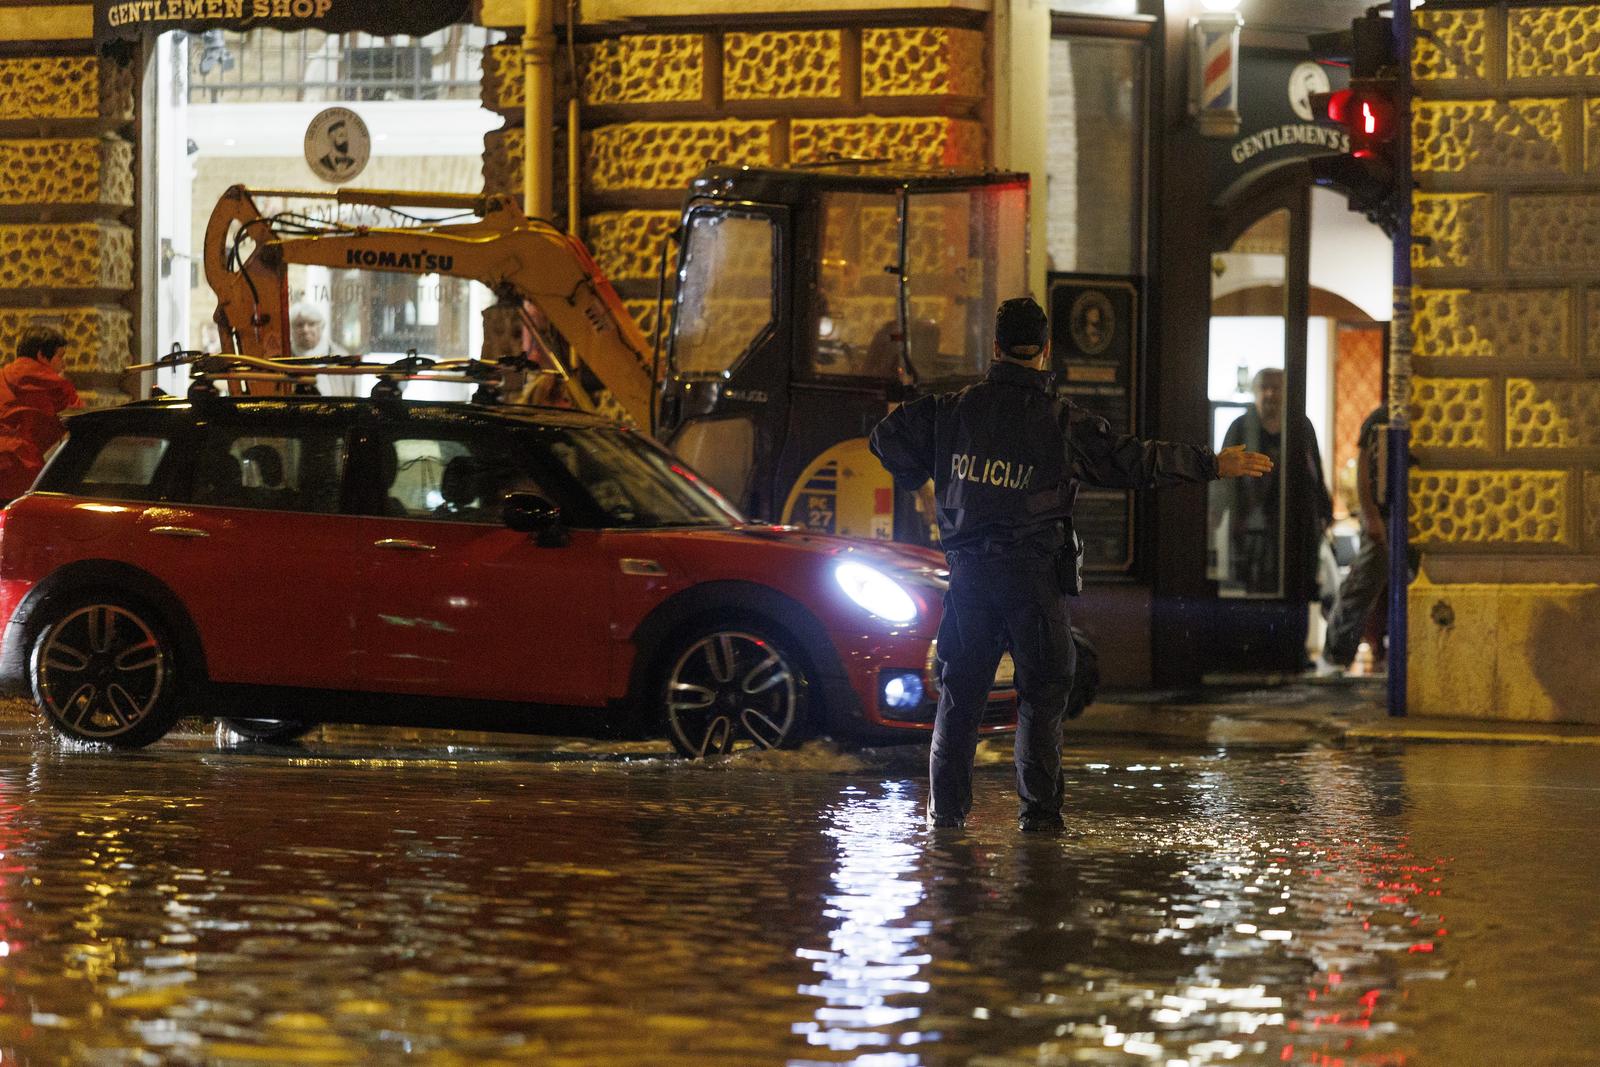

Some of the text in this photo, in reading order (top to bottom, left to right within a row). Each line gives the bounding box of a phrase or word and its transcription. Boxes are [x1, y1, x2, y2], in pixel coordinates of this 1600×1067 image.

[107, 0, 332, 27] GENTLEMEN SHOP
[1231, 125, 1340, 164] GENTLEMEN'S
[346, 249, 452, 271] KOMATSU
[951, 453, 1034, 489] POLICIJA
[809, 511, 834, 527] 27
